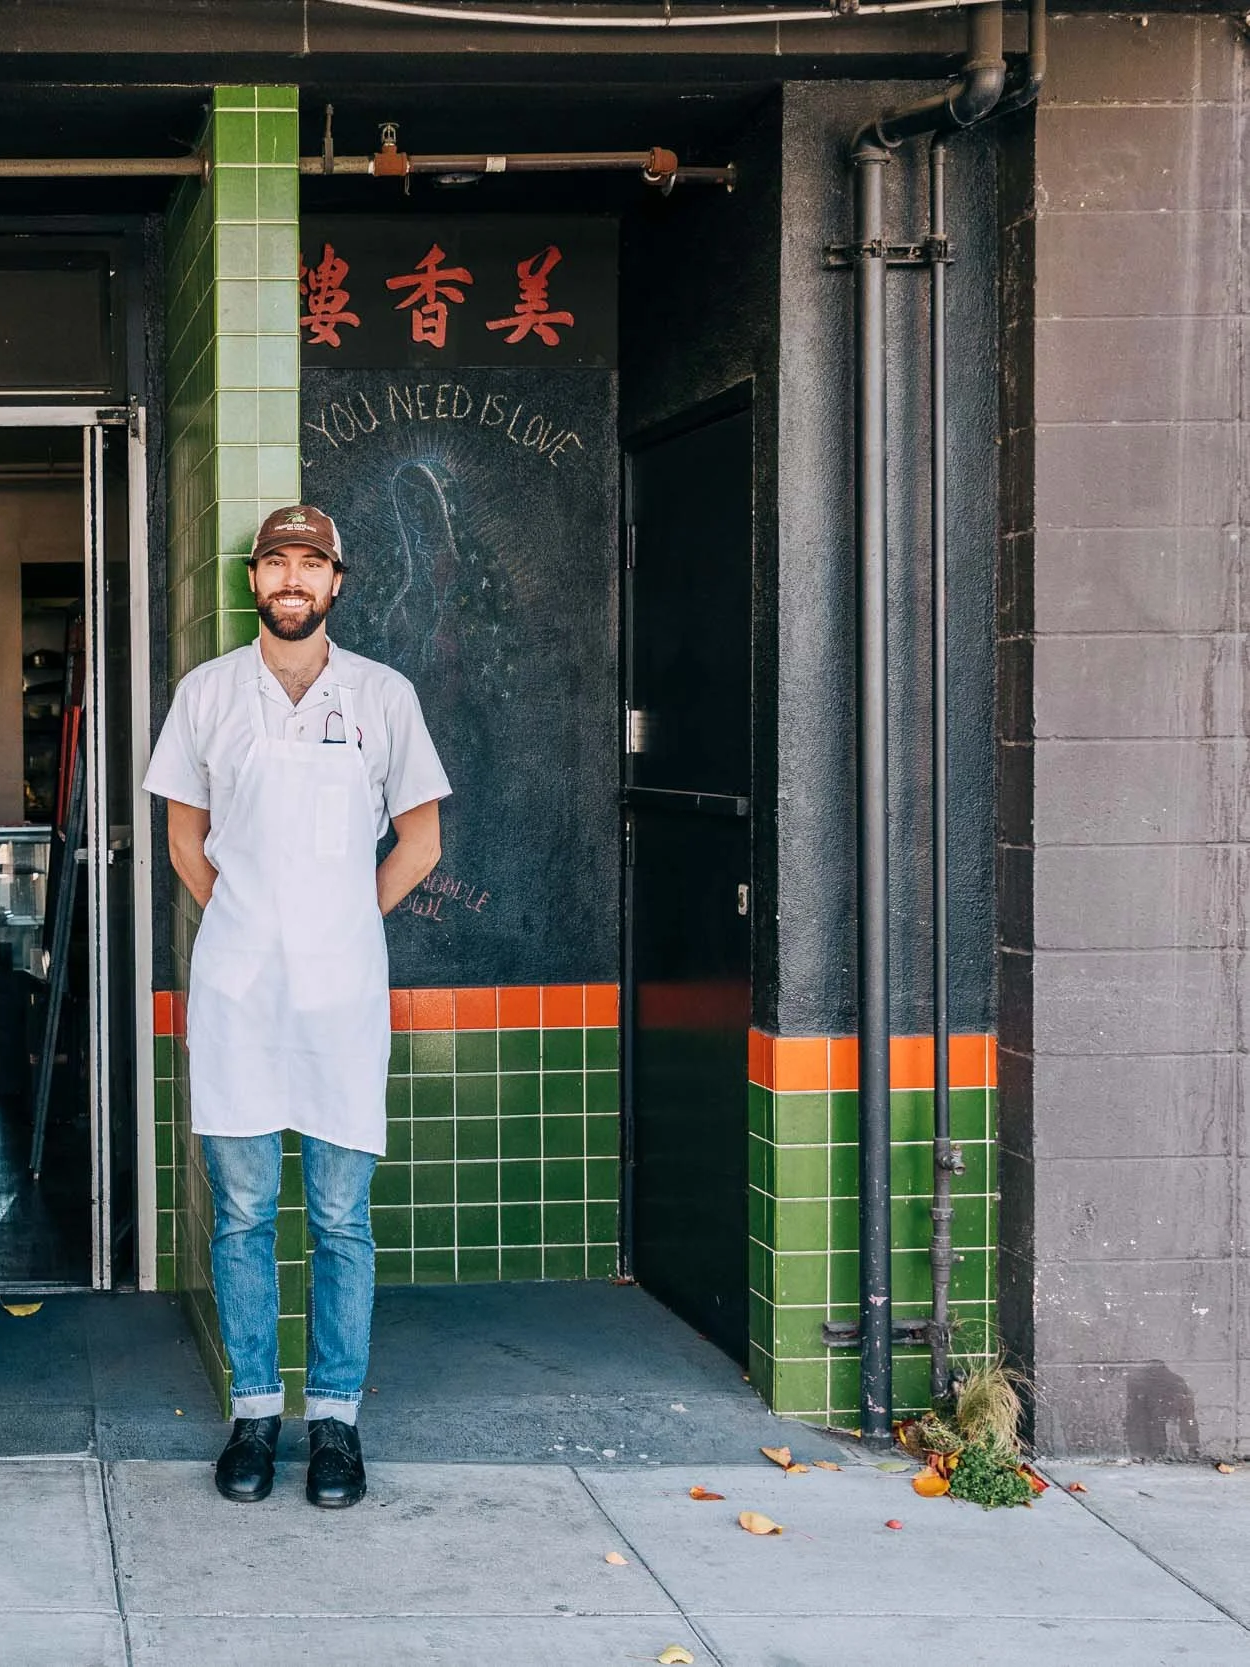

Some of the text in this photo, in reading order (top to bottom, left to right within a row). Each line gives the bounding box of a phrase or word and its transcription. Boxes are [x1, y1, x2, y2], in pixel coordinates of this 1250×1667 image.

[305, 384, 583, 468] YOU NEED IS LOVE
